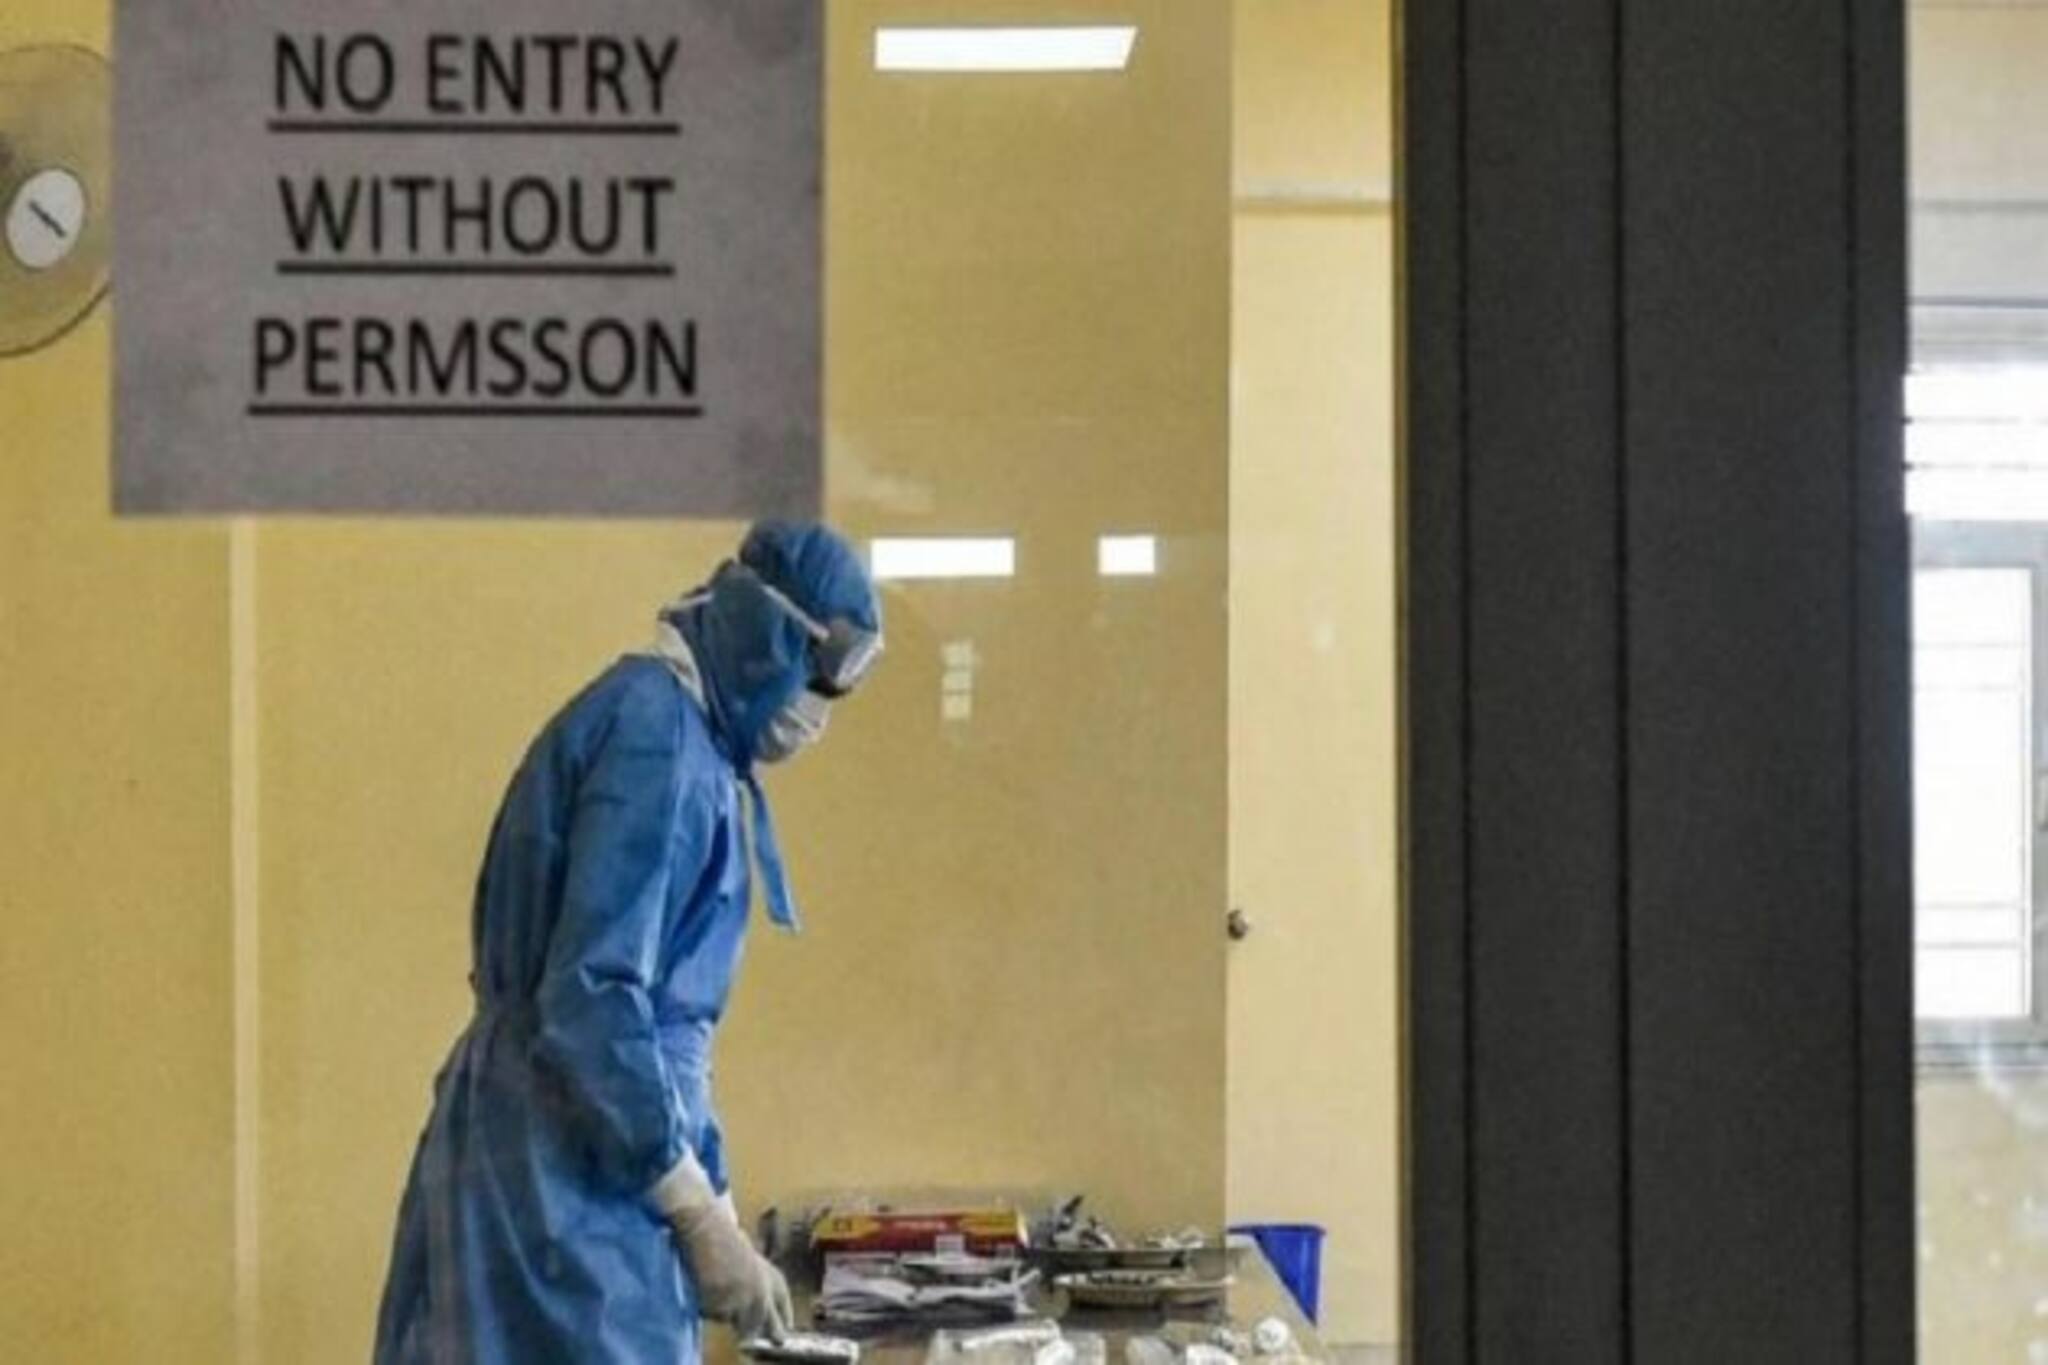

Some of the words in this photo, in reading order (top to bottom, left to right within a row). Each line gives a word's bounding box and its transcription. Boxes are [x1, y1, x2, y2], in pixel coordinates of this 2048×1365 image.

[274, 32, 395, 114] NO
[426, 35, 680, 114] ENTRY
[277, 175, 676, 255] WITHOUT
[254, 317, 697, 397] PERMSSON
